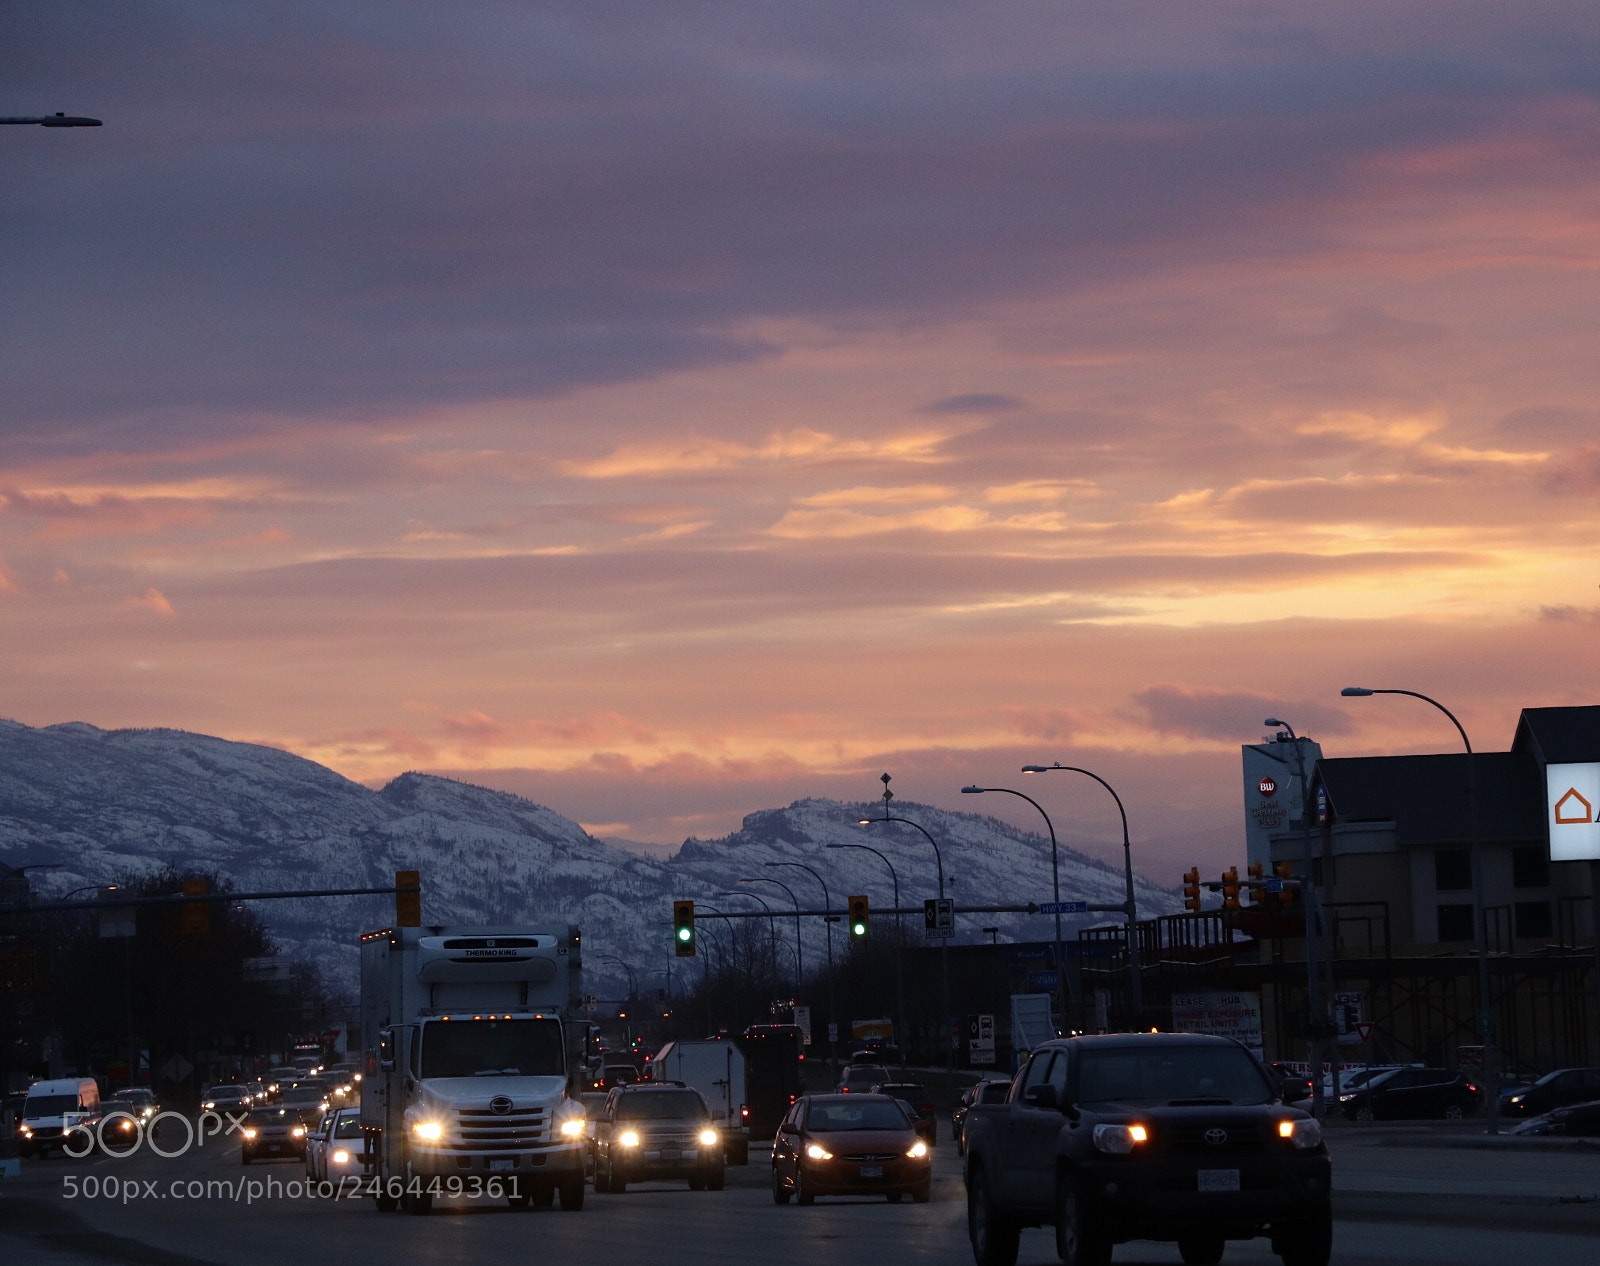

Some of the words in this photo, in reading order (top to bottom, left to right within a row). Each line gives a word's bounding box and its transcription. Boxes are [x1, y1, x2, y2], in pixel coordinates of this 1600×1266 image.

[1260, 783, 1275, 792] BW
[1065, 903, 1077, 912] 33
[1175, 998, 1205, 1006] LEASE
[1221, 996, 1241, 1004] HUB
[1177, 1021, 1209, 1029] RETAIL
[1212, 1019, 1239, 1028] UNITS
